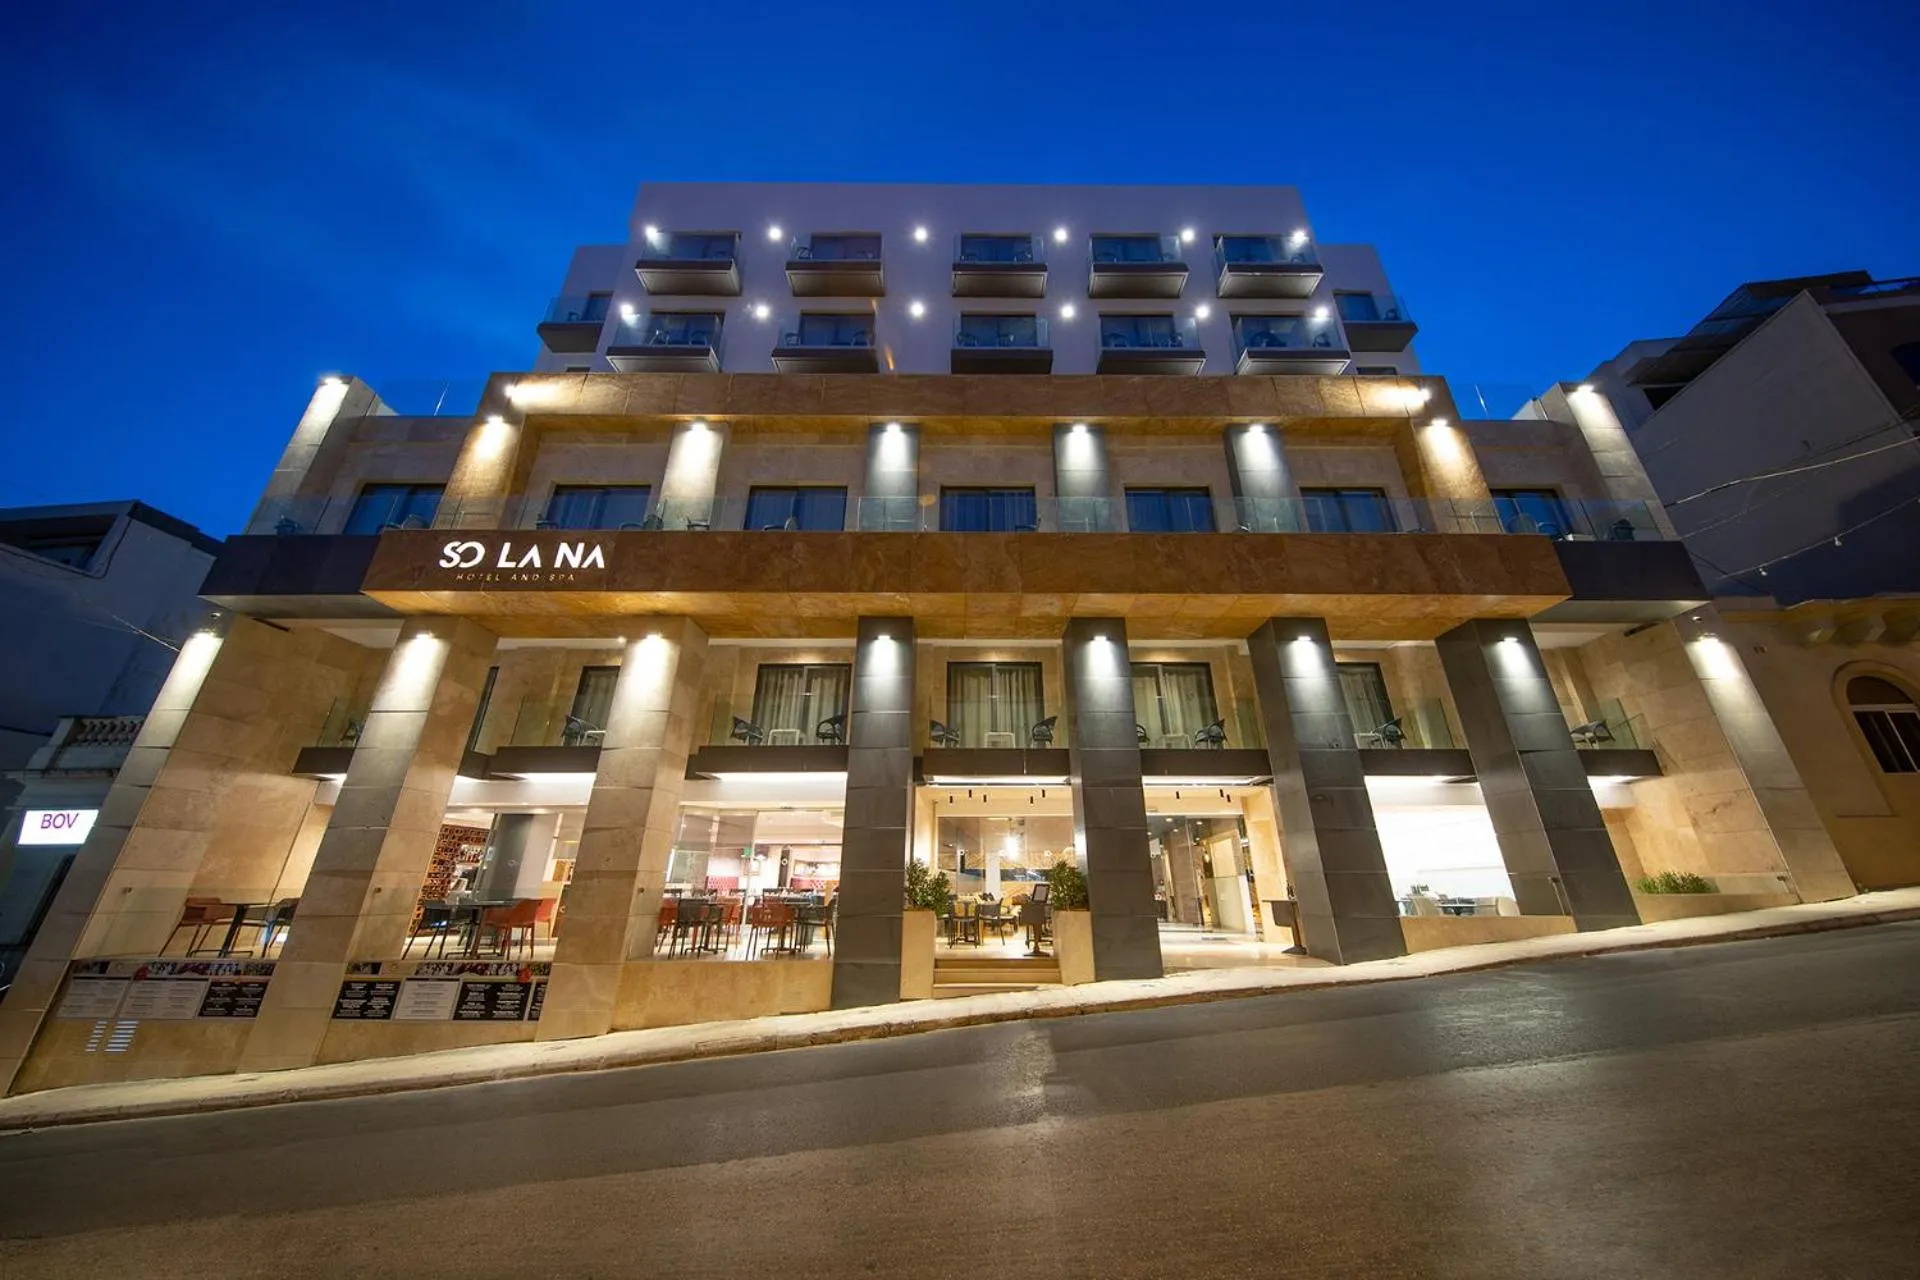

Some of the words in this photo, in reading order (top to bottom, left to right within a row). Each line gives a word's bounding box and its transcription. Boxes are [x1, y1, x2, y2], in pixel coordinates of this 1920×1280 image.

[439, 541, 485, 568] SO
[496, 542, 541, 568] LA
[553, 542, 605, 568] NA
[456, 574, 500, 582] HOTEL
[511, 574, 539, 582] AND
[549, 574, 575, 582] SPA
[41, 812, 79, 829] BOV
